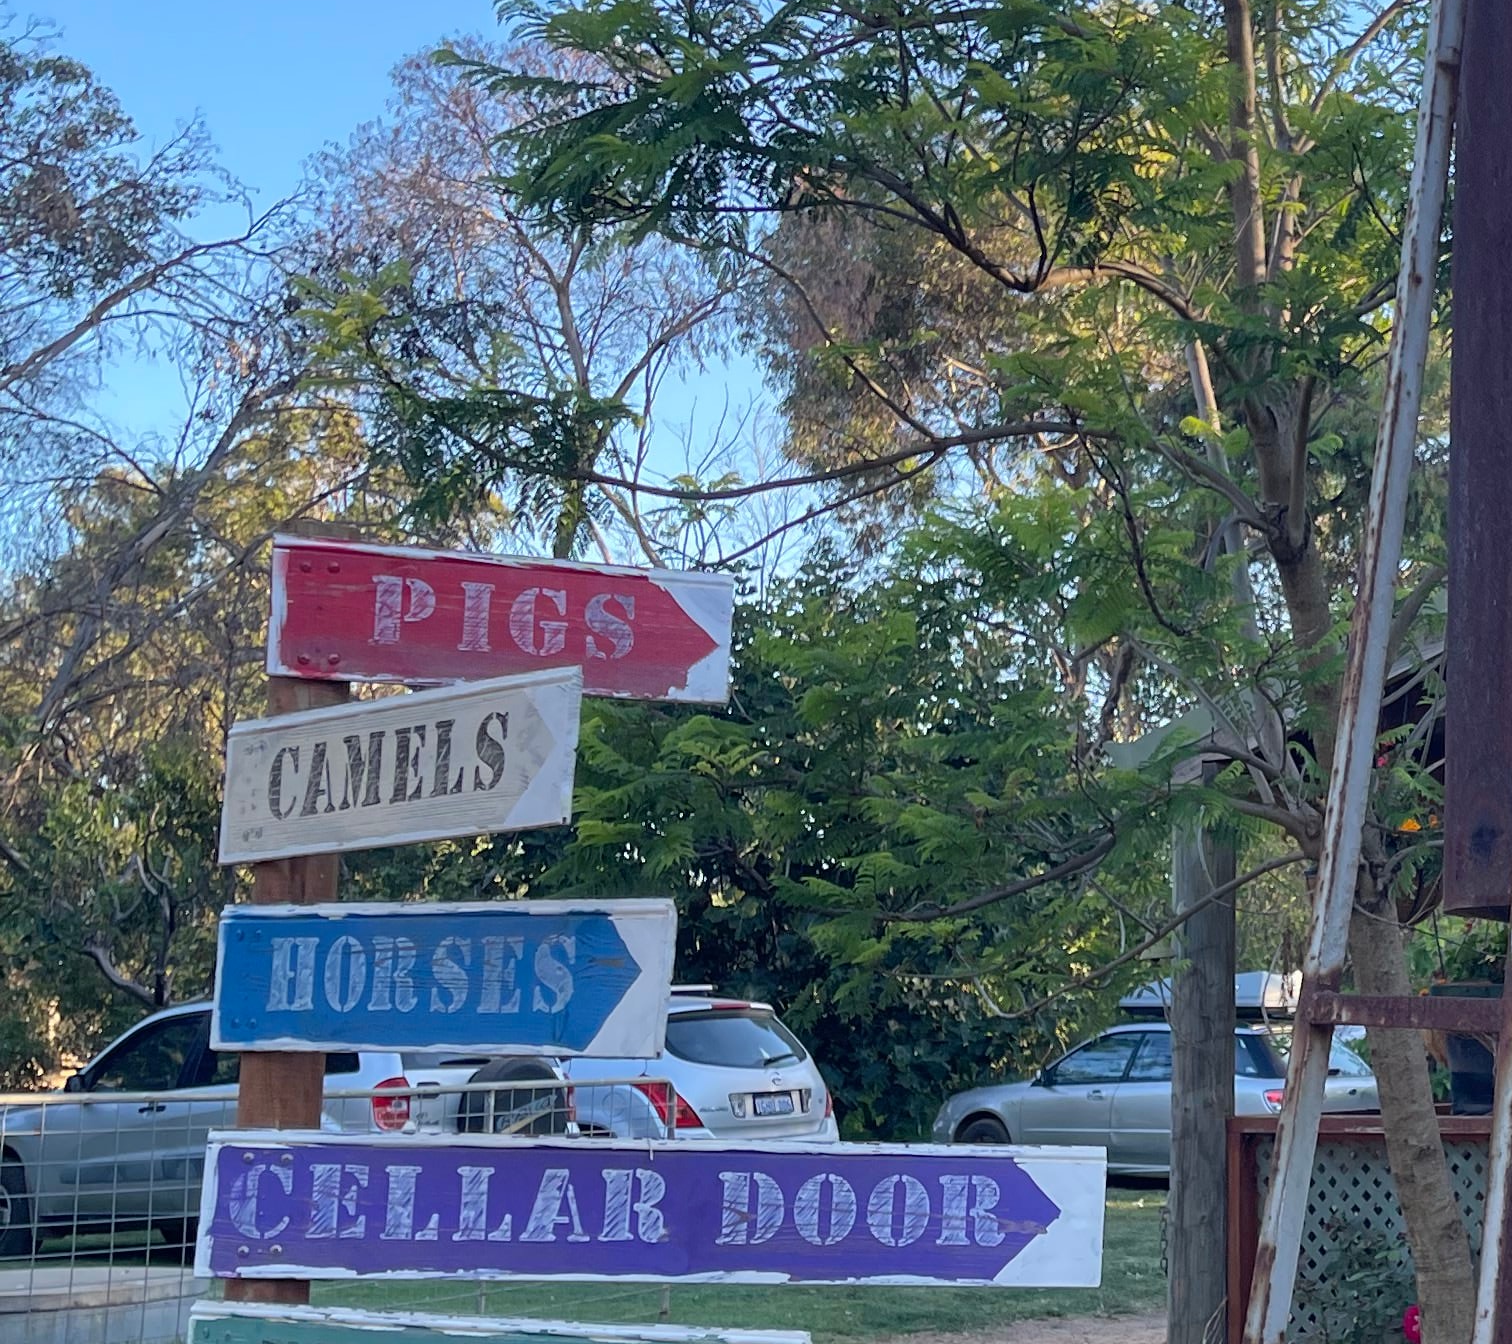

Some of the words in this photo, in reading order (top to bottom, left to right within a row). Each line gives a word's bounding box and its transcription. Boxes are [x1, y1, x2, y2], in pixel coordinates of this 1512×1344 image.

[368, 574, 636, 661] PIGS
[267, 711, 510, 822] CAMELS
[264, 934, 577, 1015] HORSES
[228, 1161, 669, 1244] CELLAR
[715, 1170, 1006, 1248] DOOR
